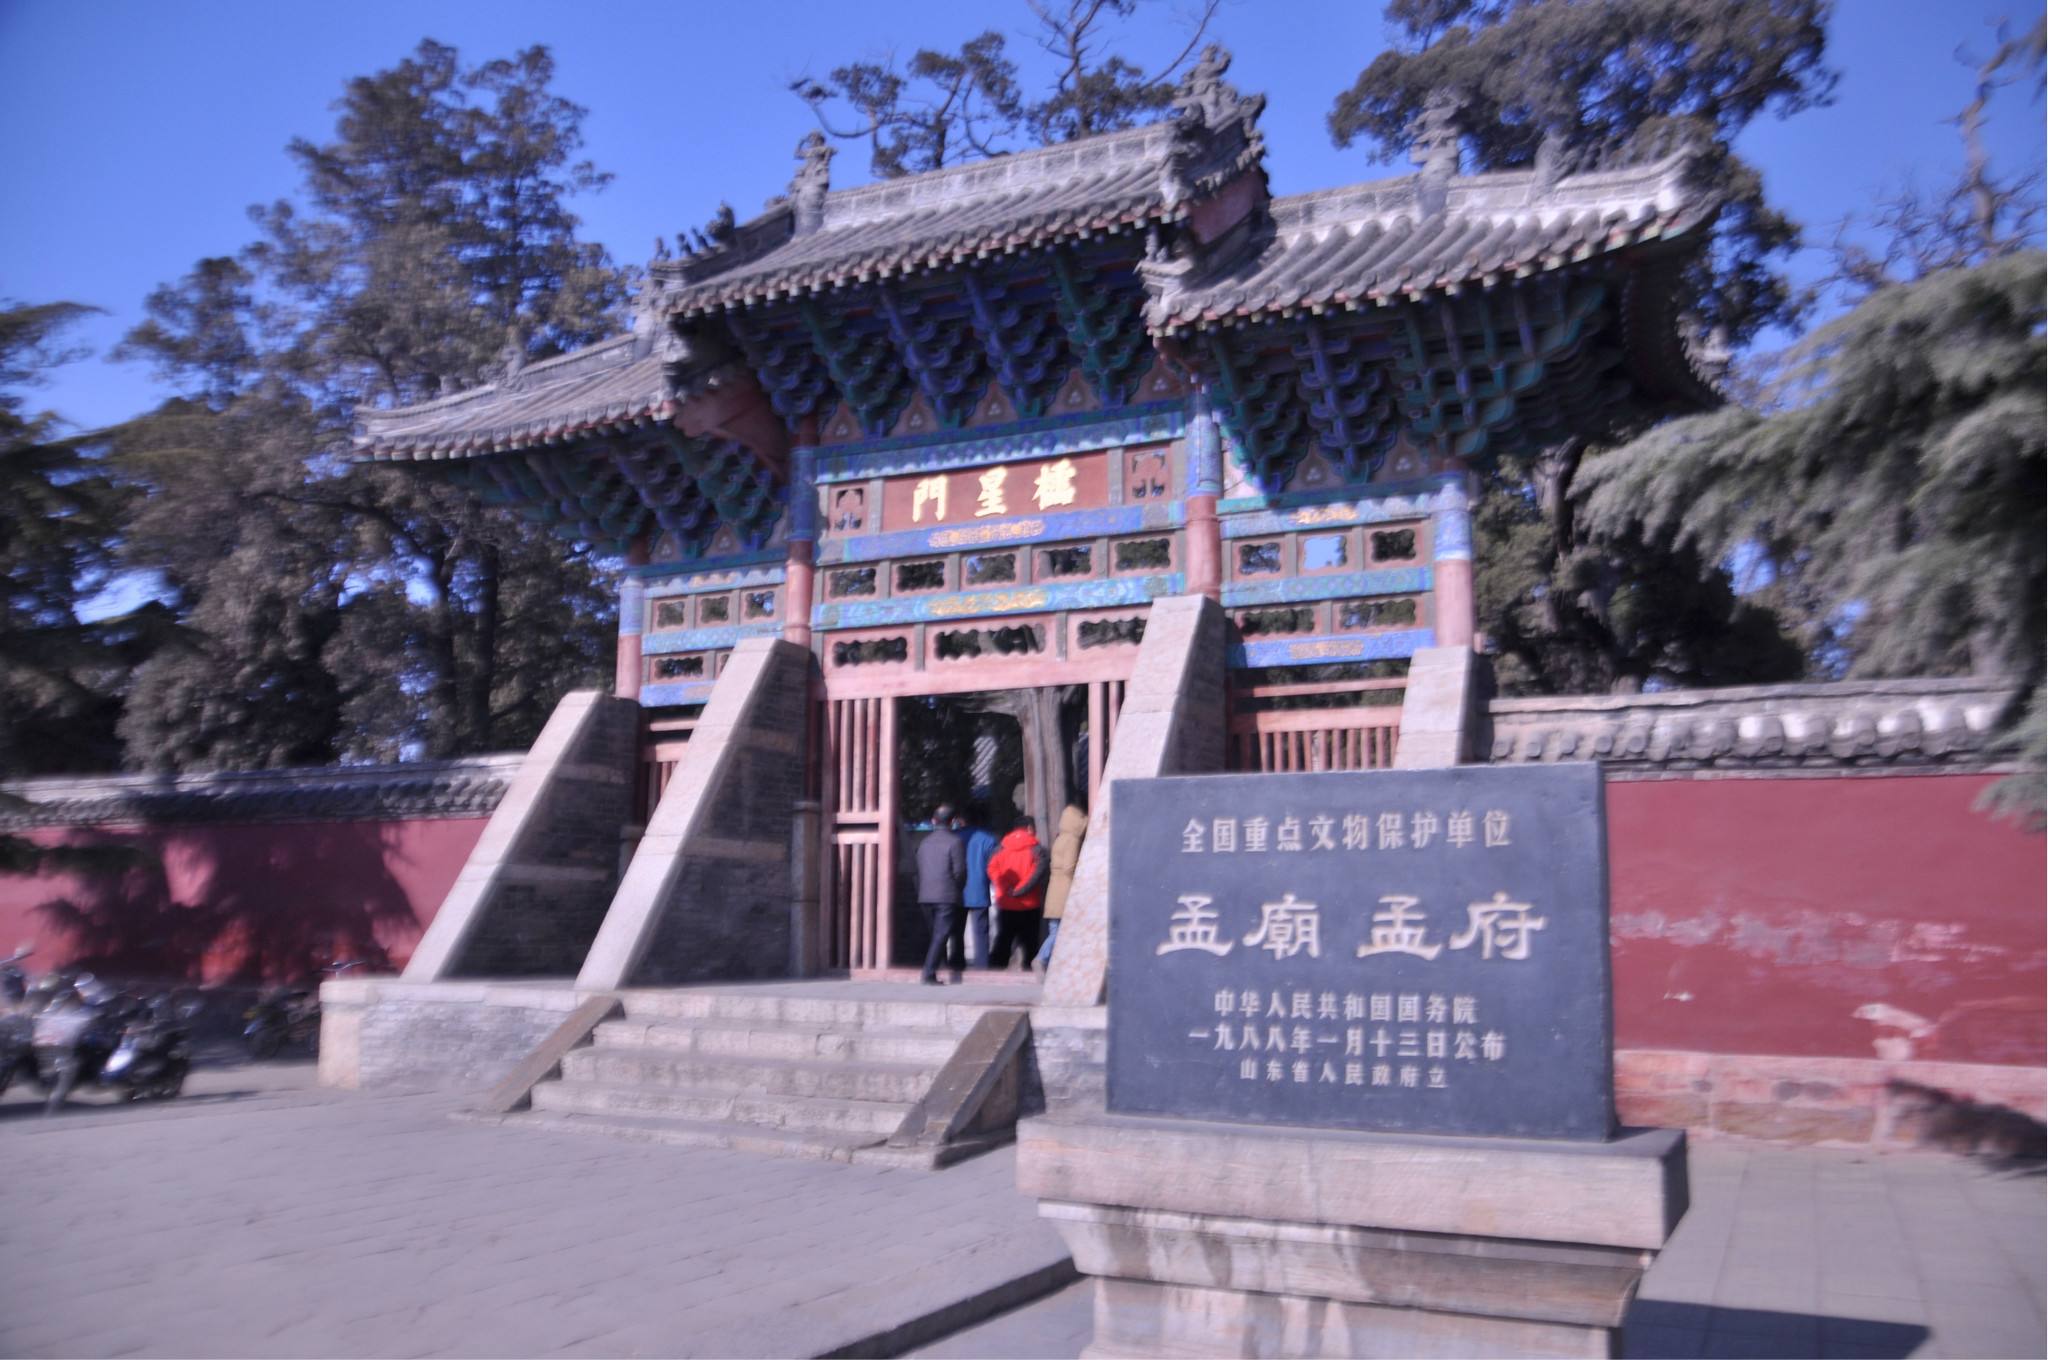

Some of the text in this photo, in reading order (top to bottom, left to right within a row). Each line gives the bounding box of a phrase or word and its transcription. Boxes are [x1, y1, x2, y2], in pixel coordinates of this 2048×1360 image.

[1182, 810, 1512, 853] 全国重点文物保护单位
[1358, 892, 1548, 961] 孟府
[1214, 989, 1478, 1025] 中华人民共和国国务院
[1189, 1023, 1506, 1060] 一九八八年一月十三日公布
[1241, 1058, 1449, 1089] 山东省人民政府立
